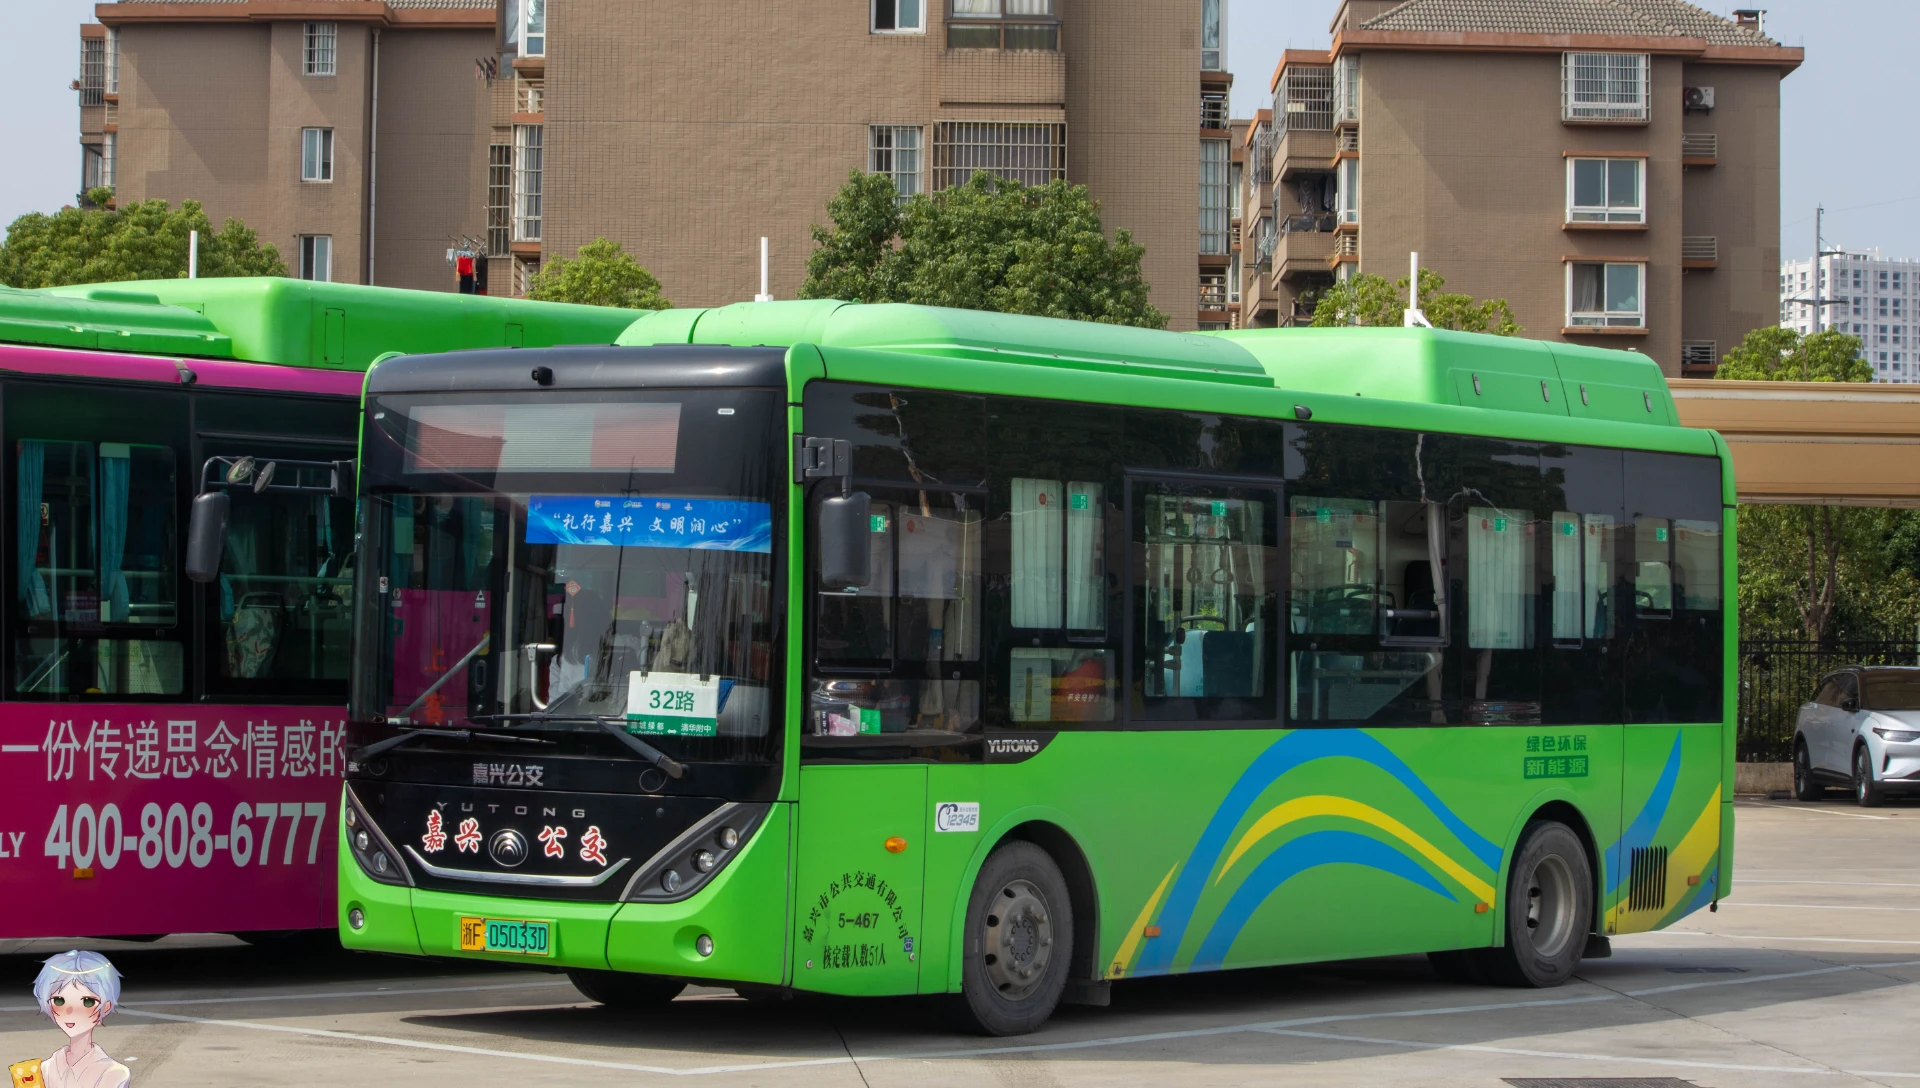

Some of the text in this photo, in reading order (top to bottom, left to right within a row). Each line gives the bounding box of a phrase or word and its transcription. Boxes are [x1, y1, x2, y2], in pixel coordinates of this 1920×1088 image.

[553, 511, 742, 535] “礼行嘉兴 文明润心”
[648, 689, 695, 712] 32路
[680, 723, 712, 733] 清华附中
[2, 719, 346, 782] 一份传递思念情感的
[988, 739, 1039, 754] YUTONG
[1526, 735, 1587, 752] 绿色环保
[472, 762, 544, 787] 嘉兴公交
[1527, 759, 1586, 776] 新能源
[436, 802, 586, 818] YUTONG
[946, 813, 978, 827] 12345
[45, 802, 326, 869] 400-808-6777
[420, 808, 609, 867] 嘉兴 公交
[802, 870, 909, 944] 嘉兴市公共交通有限公司
[838, 912, 880, 929] 5-467
[462, 924, 548, 951] 浙F 05033D
[823, 945, 886, 968] 核定载人数51人
